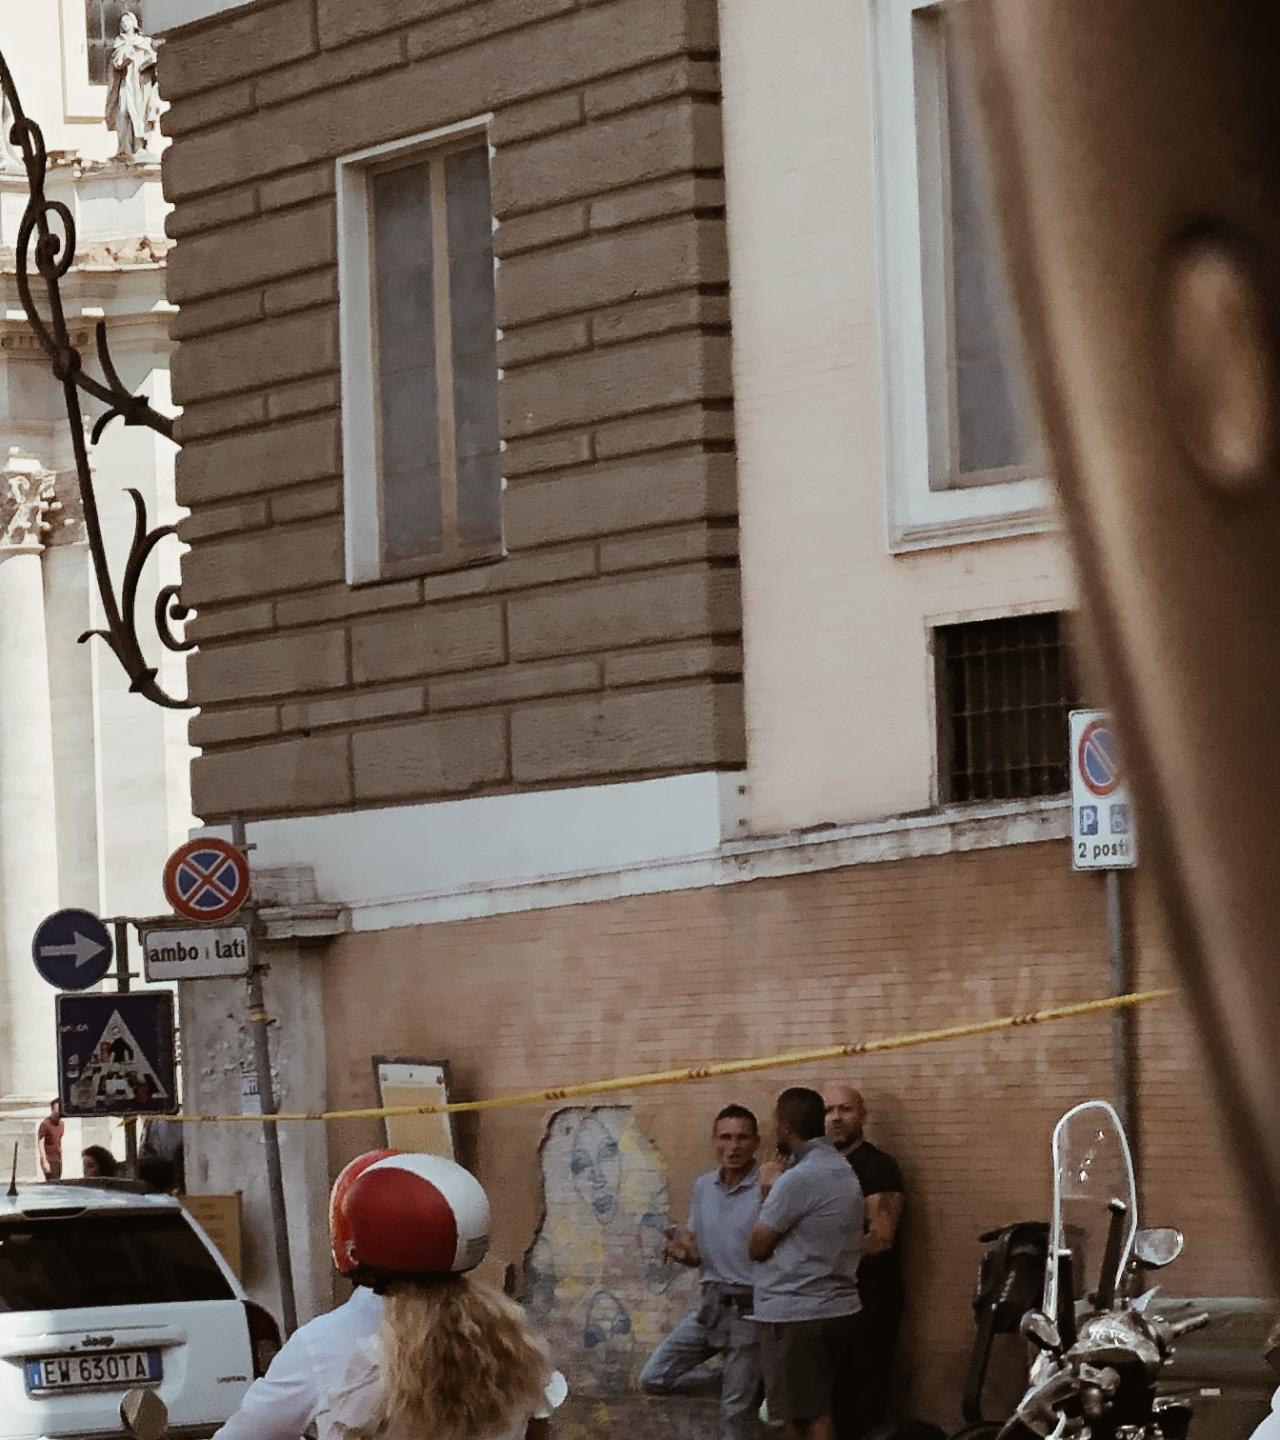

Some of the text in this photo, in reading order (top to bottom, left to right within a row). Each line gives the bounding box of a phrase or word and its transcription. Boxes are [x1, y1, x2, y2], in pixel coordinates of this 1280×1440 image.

[1078, 842, 1088, 859] 2
[149, 941, 199, 962] ambo
[215, 938, 246, 958] lati
